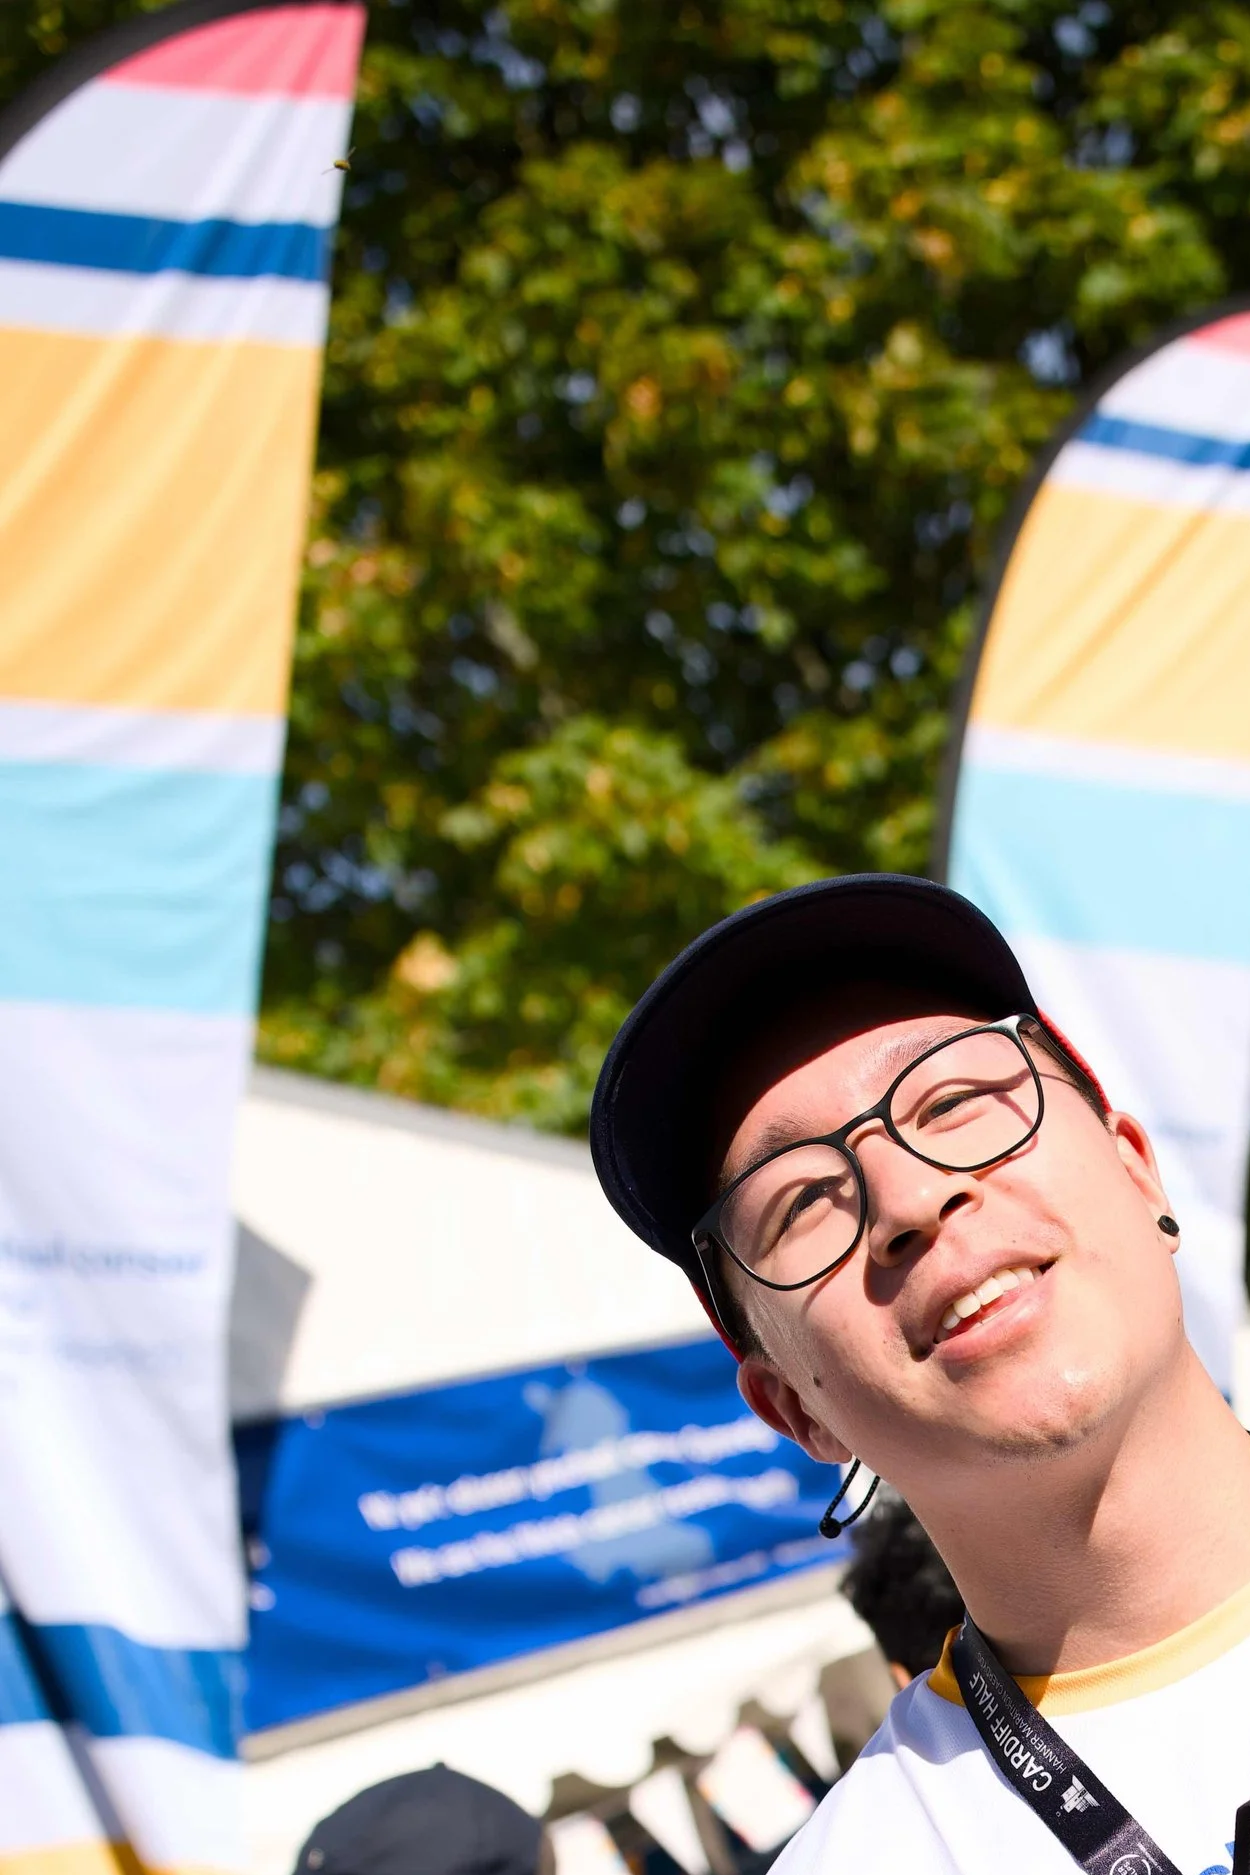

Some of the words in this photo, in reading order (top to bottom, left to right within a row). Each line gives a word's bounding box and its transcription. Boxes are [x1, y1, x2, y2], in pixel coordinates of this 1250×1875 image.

[969, 1672, 998, 1720] HALF
[999, 1693, 1036, 1738] MARATHON
[990, 1715, 1052, 1791] CARDIFF
[1030, 1733, 1067, 1774] HANNER
